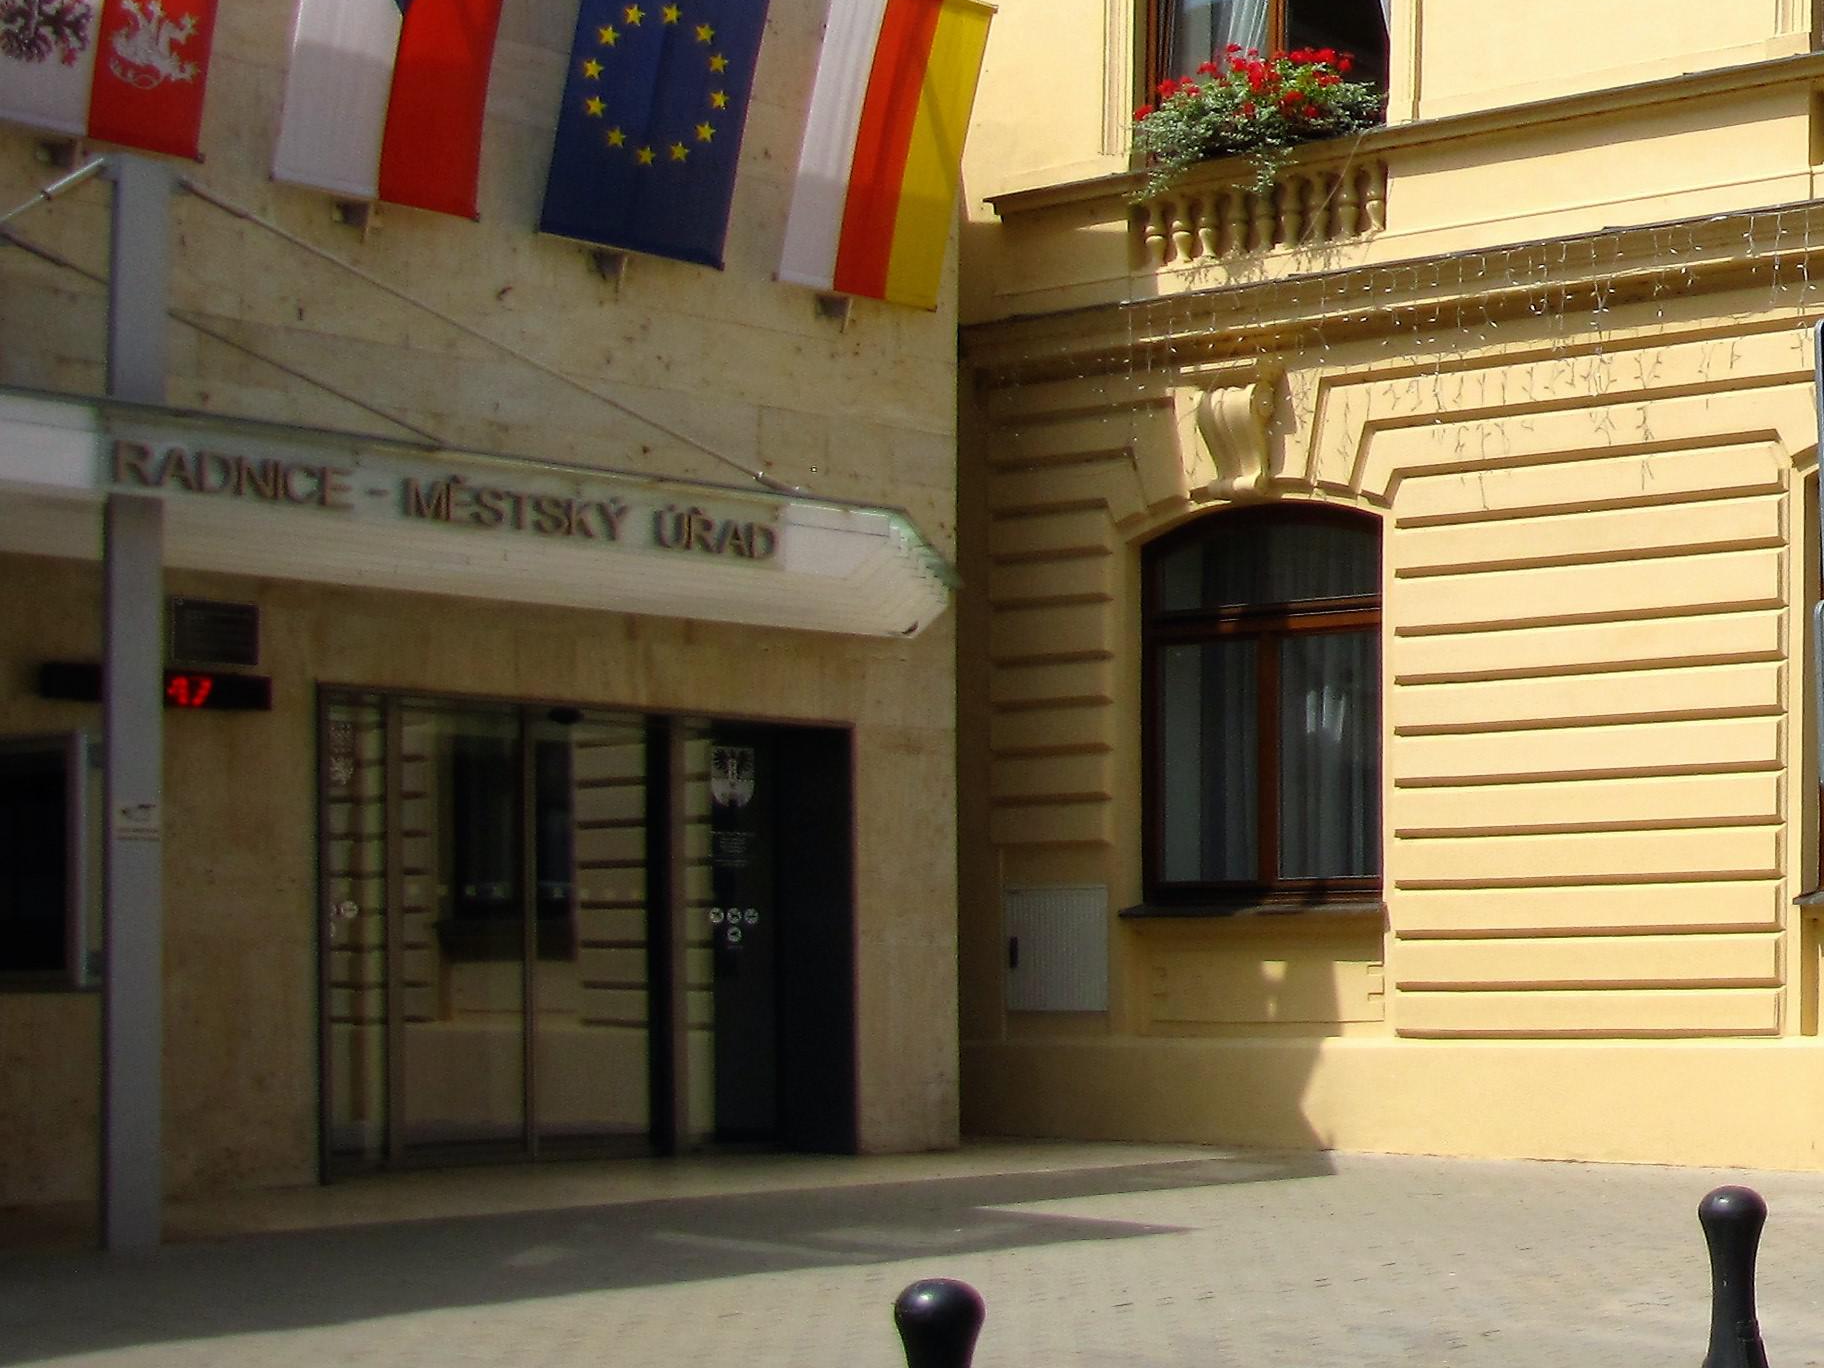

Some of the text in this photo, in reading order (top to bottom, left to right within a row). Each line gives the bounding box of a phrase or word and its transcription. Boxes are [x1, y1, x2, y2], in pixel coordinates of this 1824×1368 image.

[112, 438, 355, 510] RADNICE
[403, 473, 632, 542] MĚSTSKÝ
[654, 503, 780, 560] ÚŘAD
